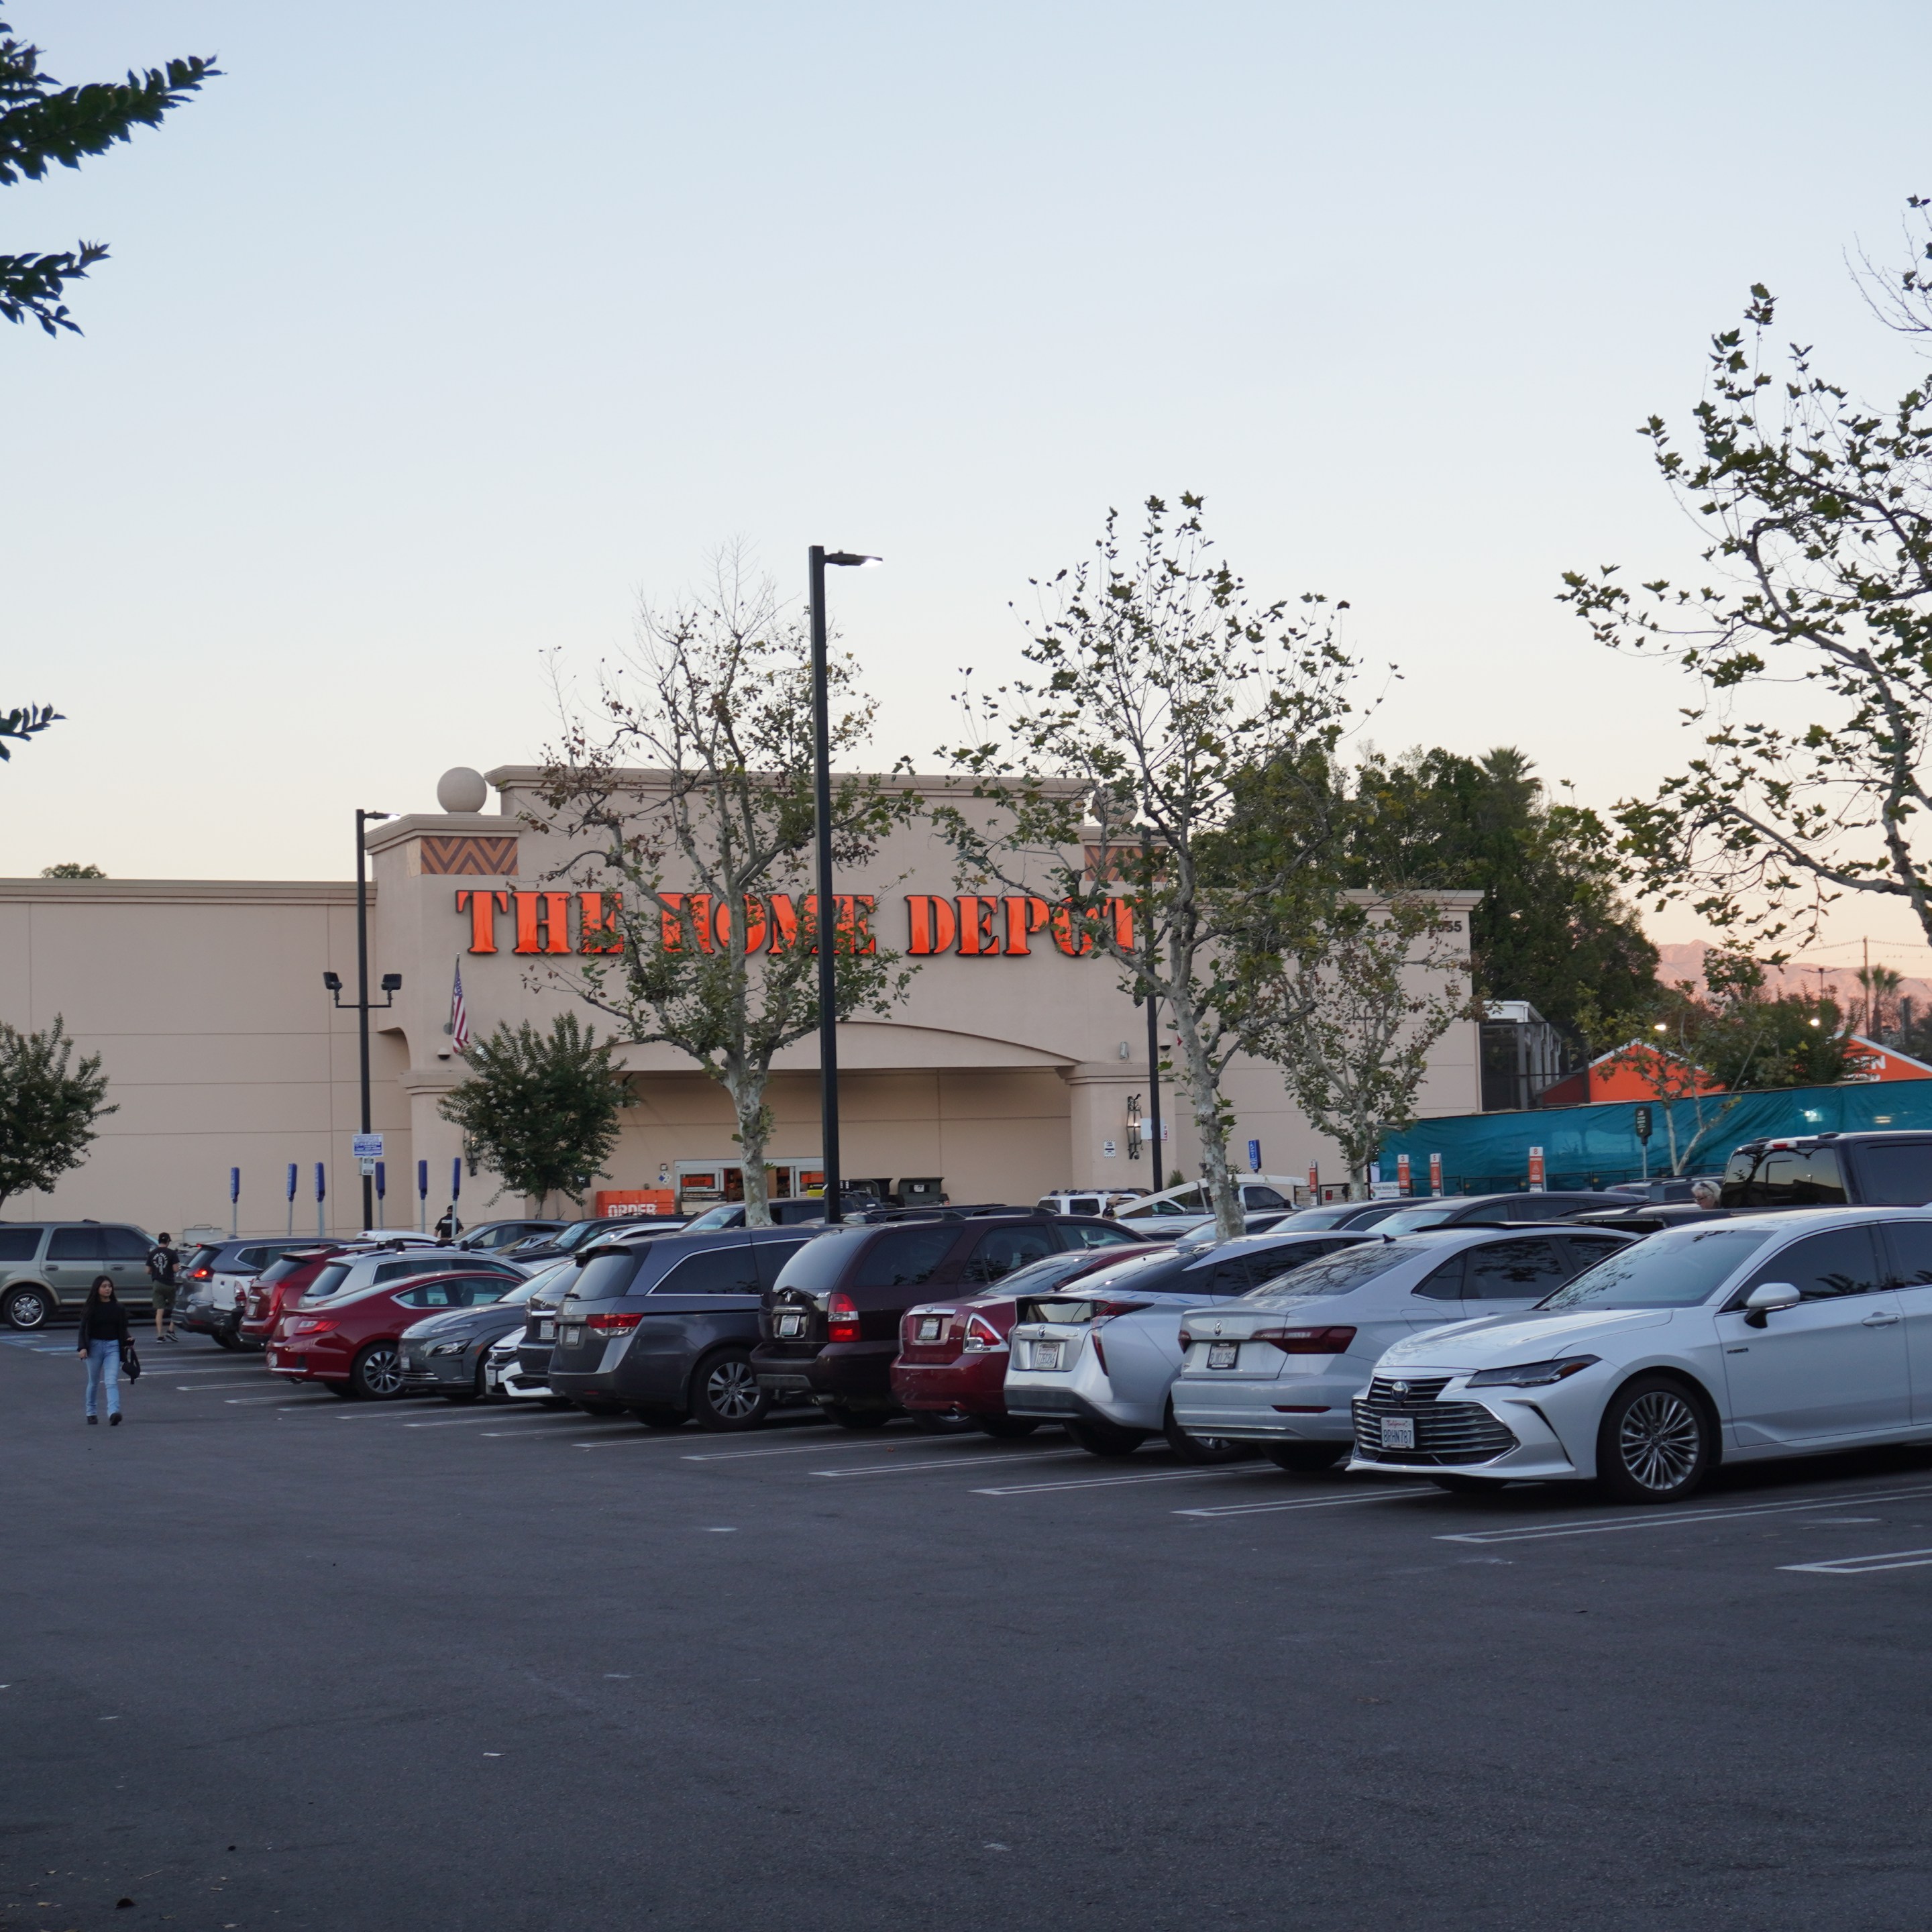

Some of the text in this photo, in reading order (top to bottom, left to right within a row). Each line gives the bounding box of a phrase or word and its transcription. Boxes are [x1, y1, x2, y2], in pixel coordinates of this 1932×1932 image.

[455, 890, 624, 955] THE
[903, 894, 1143, 957] DEPOT
[608, 1203, 657, 1218] ORDER
